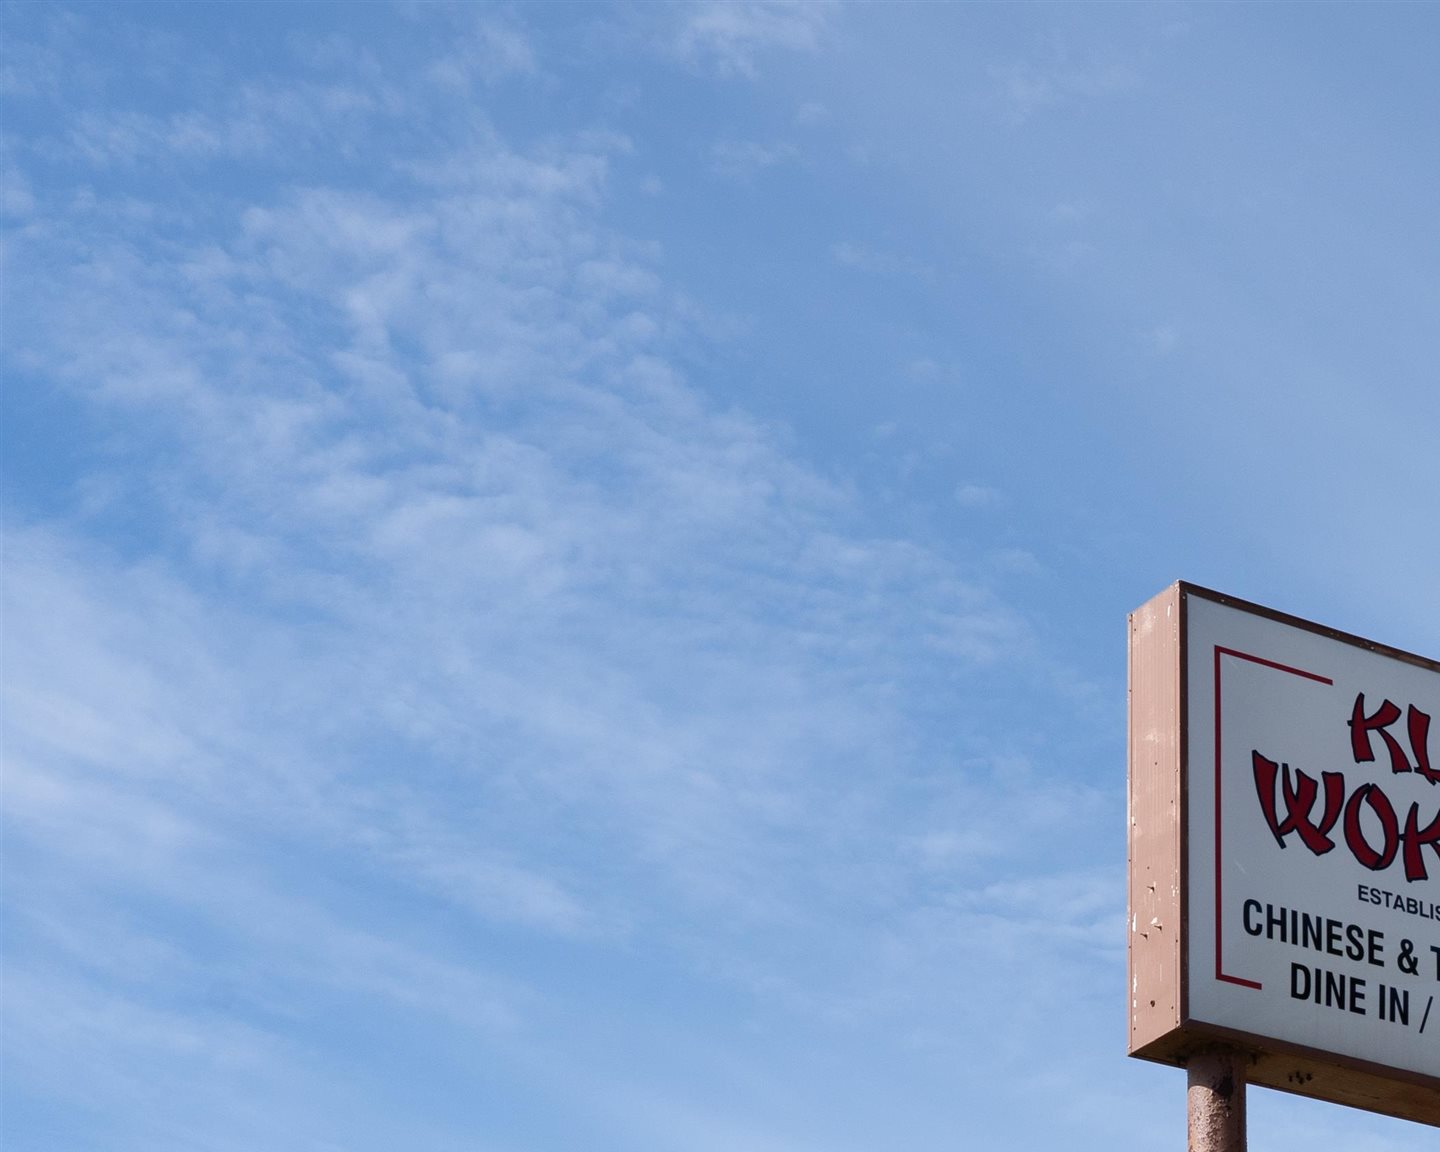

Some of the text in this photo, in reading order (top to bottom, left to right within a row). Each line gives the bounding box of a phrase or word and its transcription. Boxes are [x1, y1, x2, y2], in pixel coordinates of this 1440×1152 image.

[1242, 898, 1385, 967] CHINESE
[1397, 938, 1419, 976] &
[1290, 963, 1366, 1016] DINE
[1379, 984, 1410, 1026] IN
[1419, 995, 1434, 1034] /
